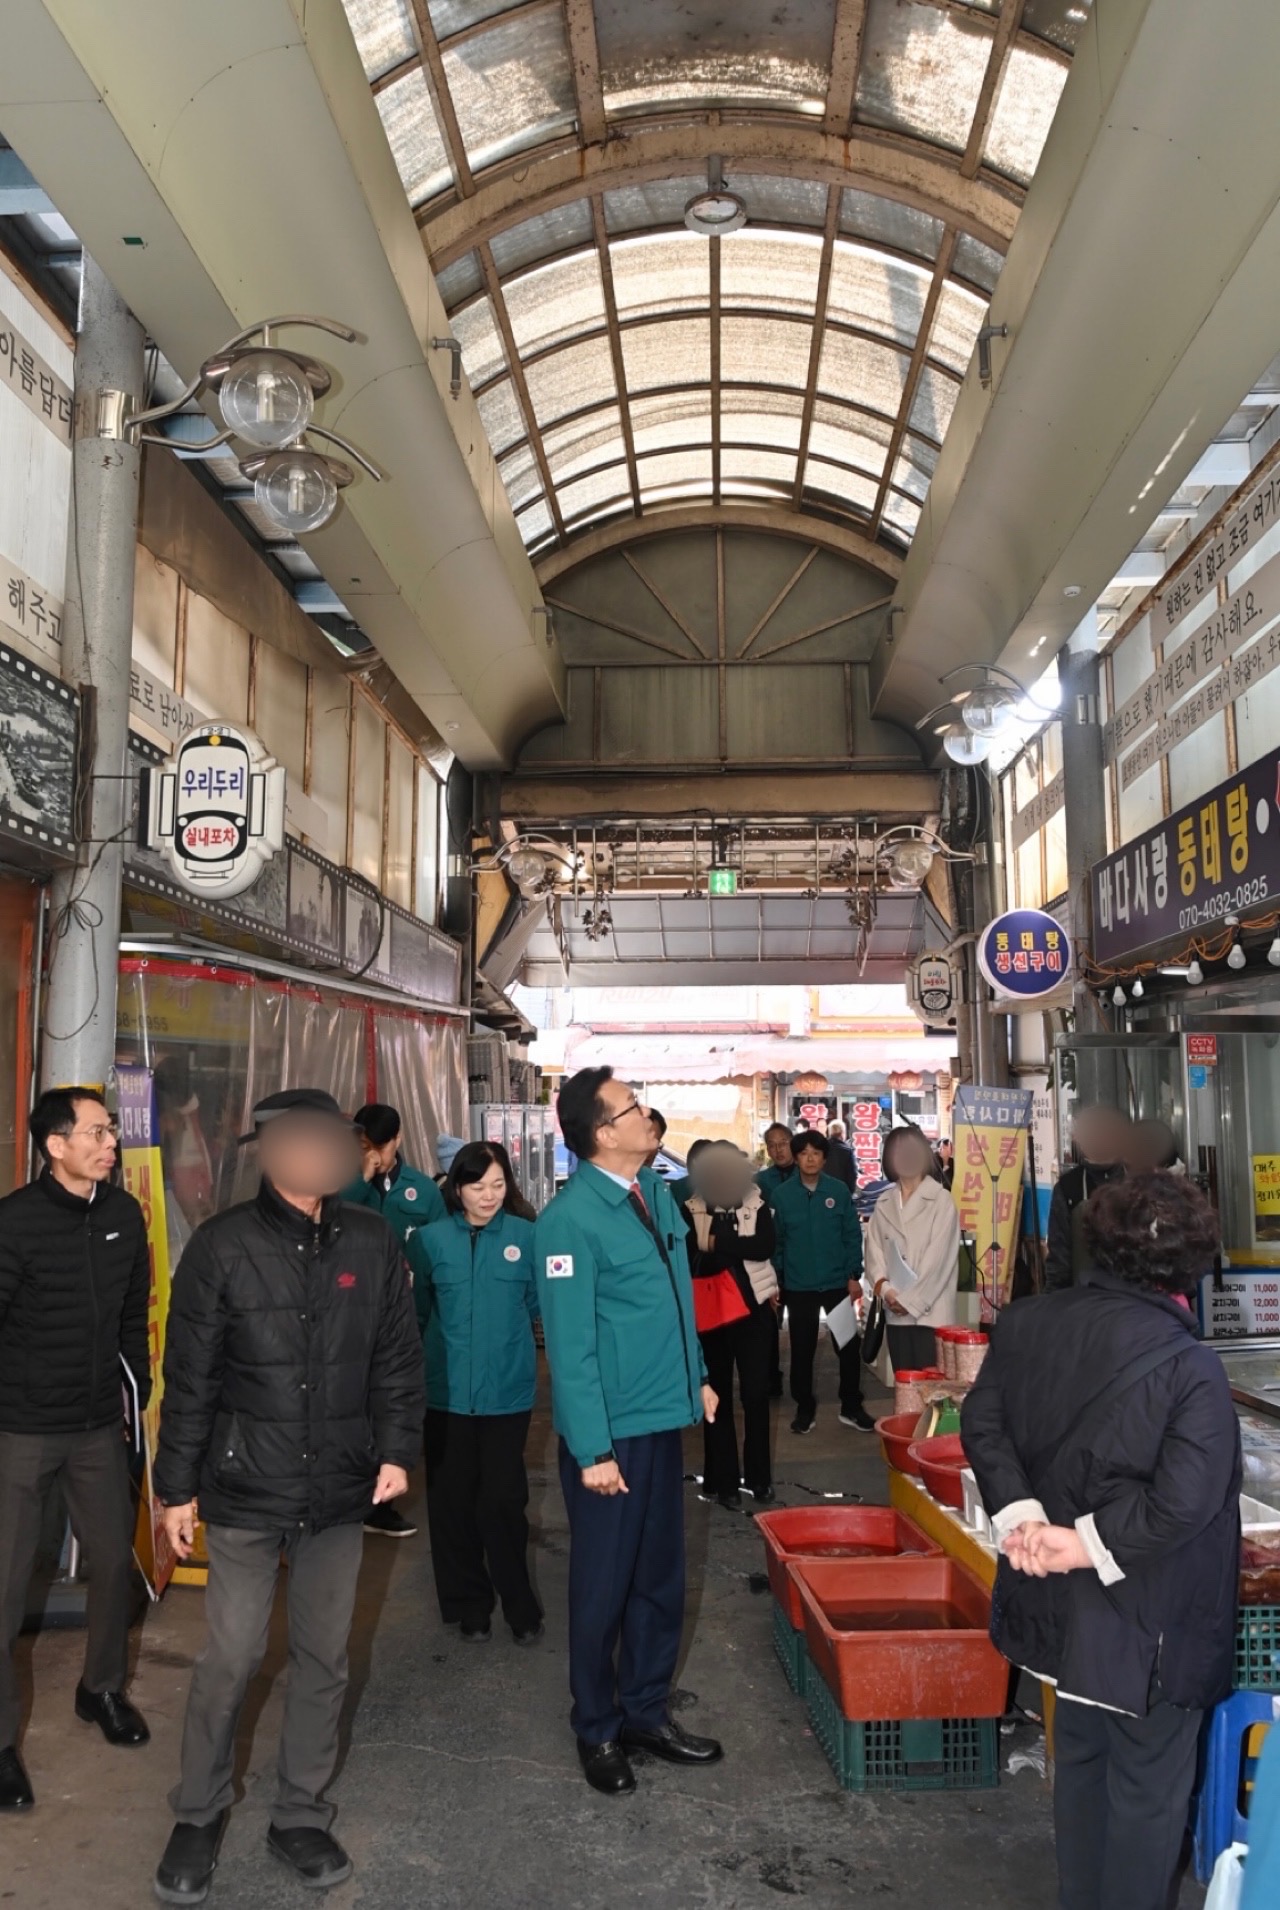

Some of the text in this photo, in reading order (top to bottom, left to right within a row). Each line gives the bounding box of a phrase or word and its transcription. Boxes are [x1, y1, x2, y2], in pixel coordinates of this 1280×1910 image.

[1229, 513, 1249, 557] 조금
[7, 577, 62, 647] 해주고
[1201, 592, 1263, 665] 감사해요.
[181, 766, 245, 800] 우리두리
[185, 827, 236, 847] 실내포차
[1098, 832, 1168, 932] 바다사랑
[1178, 783, 1249, 897] 동태탕
[1179, 875, 1268, 930] 070-4032-0825
[995, 951, 1062, 974] 생선구이
[1190, 1038, 1214, 1046] CCTV
[1254, 1284, 1279, 1293] 11,000
[1253, 1298, 1279, 1308] 12,000
[1255, 1313, 1280, 1322] 11,000
